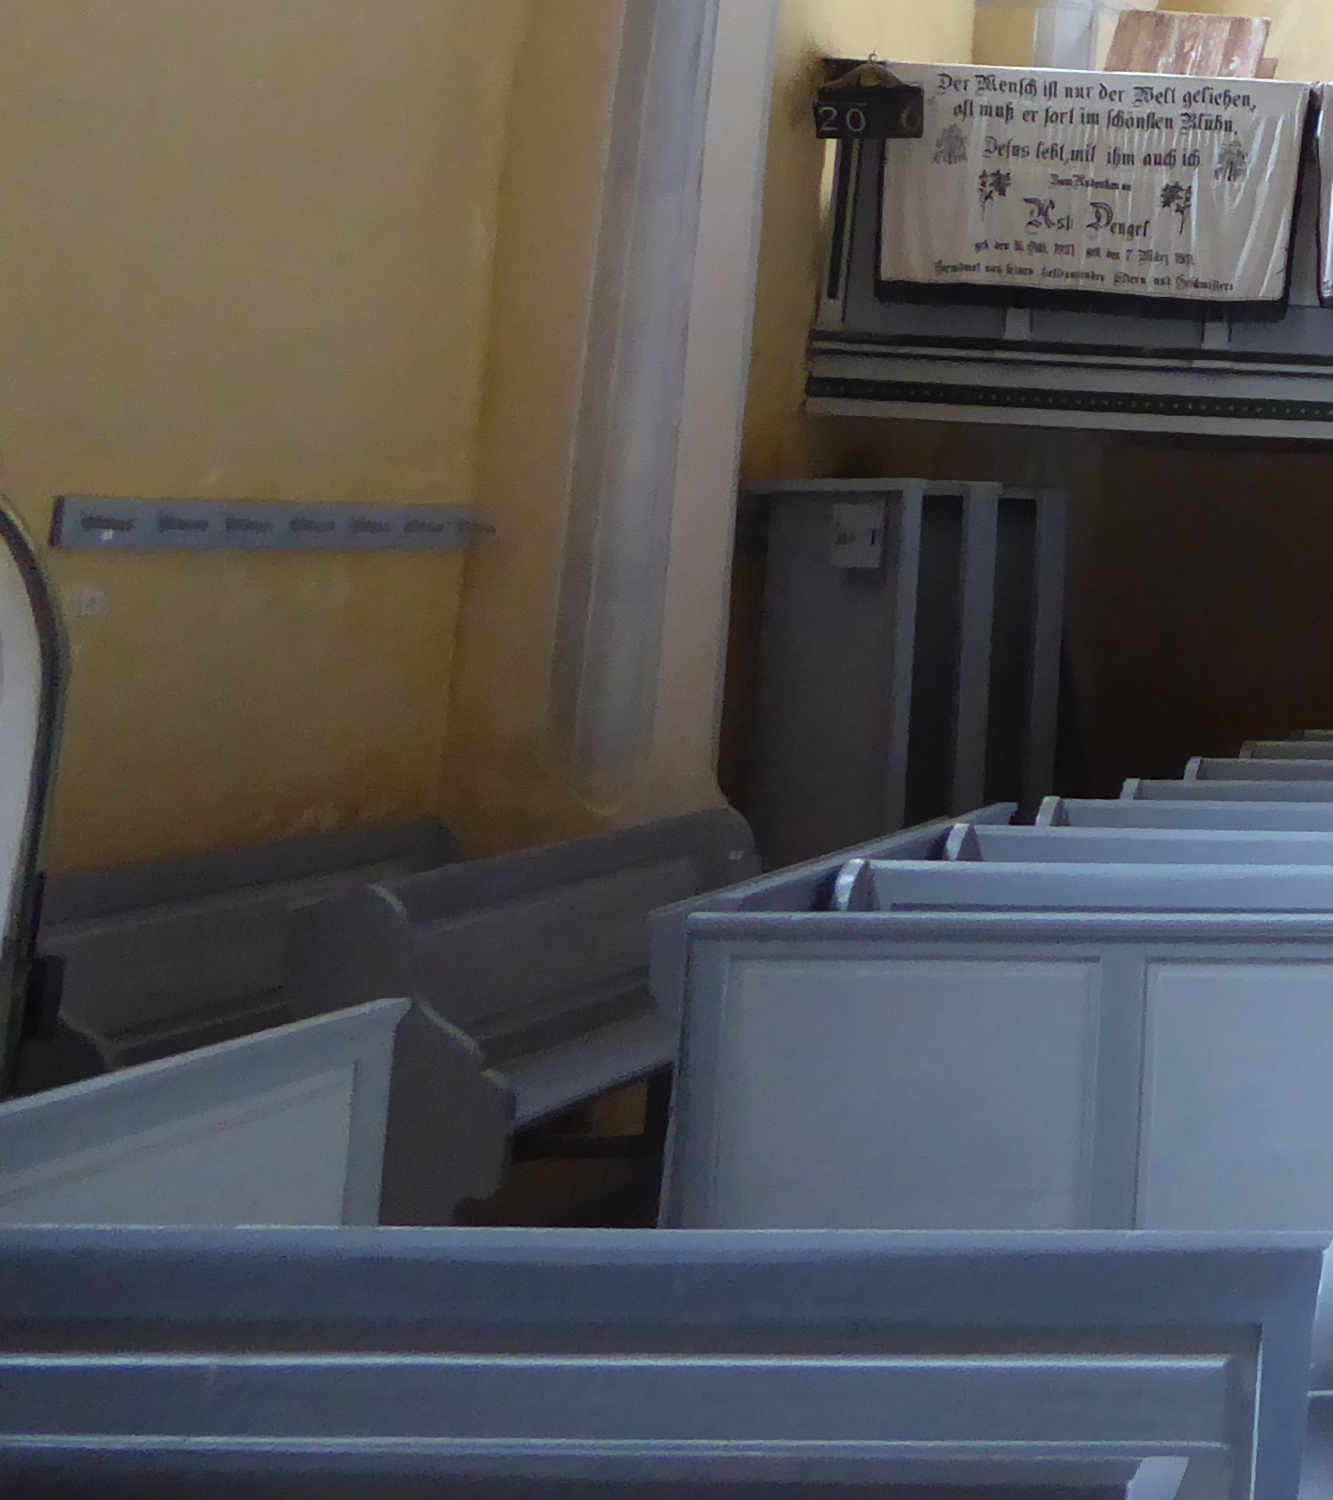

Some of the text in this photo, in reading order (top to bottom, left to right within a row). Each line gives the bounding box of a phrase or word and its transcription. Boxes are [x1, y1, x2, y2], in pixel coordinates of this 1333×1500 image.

[937, 73, 970, 95] Der
[974, 74, 1038, 97] Mensch
[1043, 80, 1058, 100] ist
[1065, 85, 1095, 100] nur
[1099, 83, 1126, 103] der
[1132, 86, 1176, 108] Welt
[953, 99, 974, 120] oft
[1022, 109, 1039, 122] er
[1044, 106, 1075, 127] fort
[1080, 107, 1100, 125] im
[983, 136, 1030, 159] Jesus
[1107, 146, 1135, 166] ihm
[1143, 148, 1176, 169] auch
